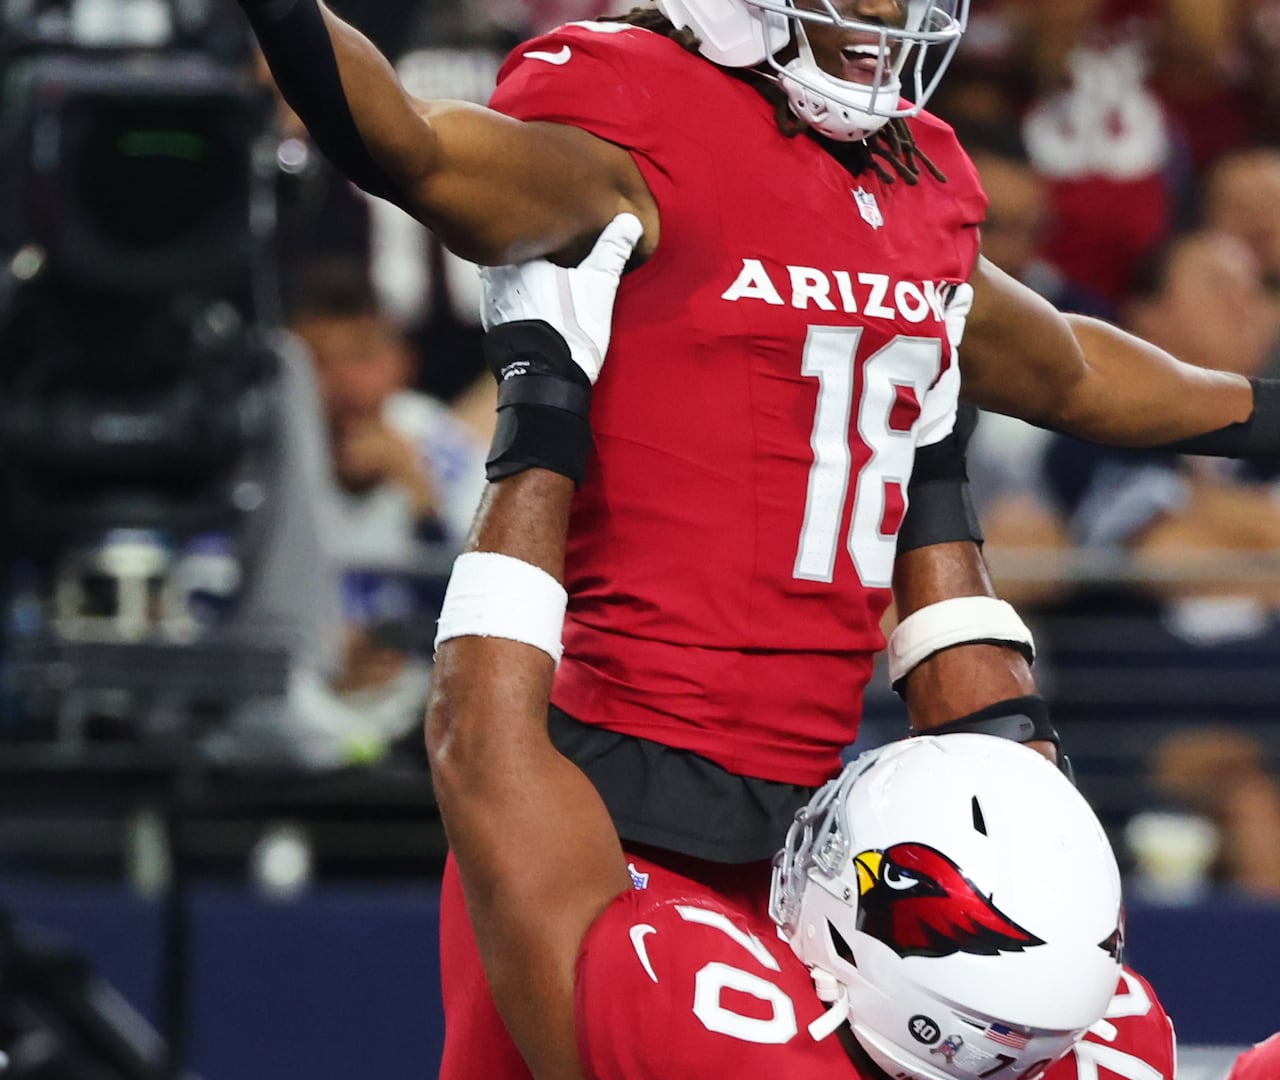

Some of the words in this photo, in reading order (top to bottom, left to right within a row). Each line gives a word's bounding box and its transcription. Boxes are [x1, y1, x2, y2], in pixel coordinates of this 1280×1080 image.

[721, 258, 946, 323] ARIZON
[793, 324, 942, 588] 18
[912, 1018, 937, 1042] 40
